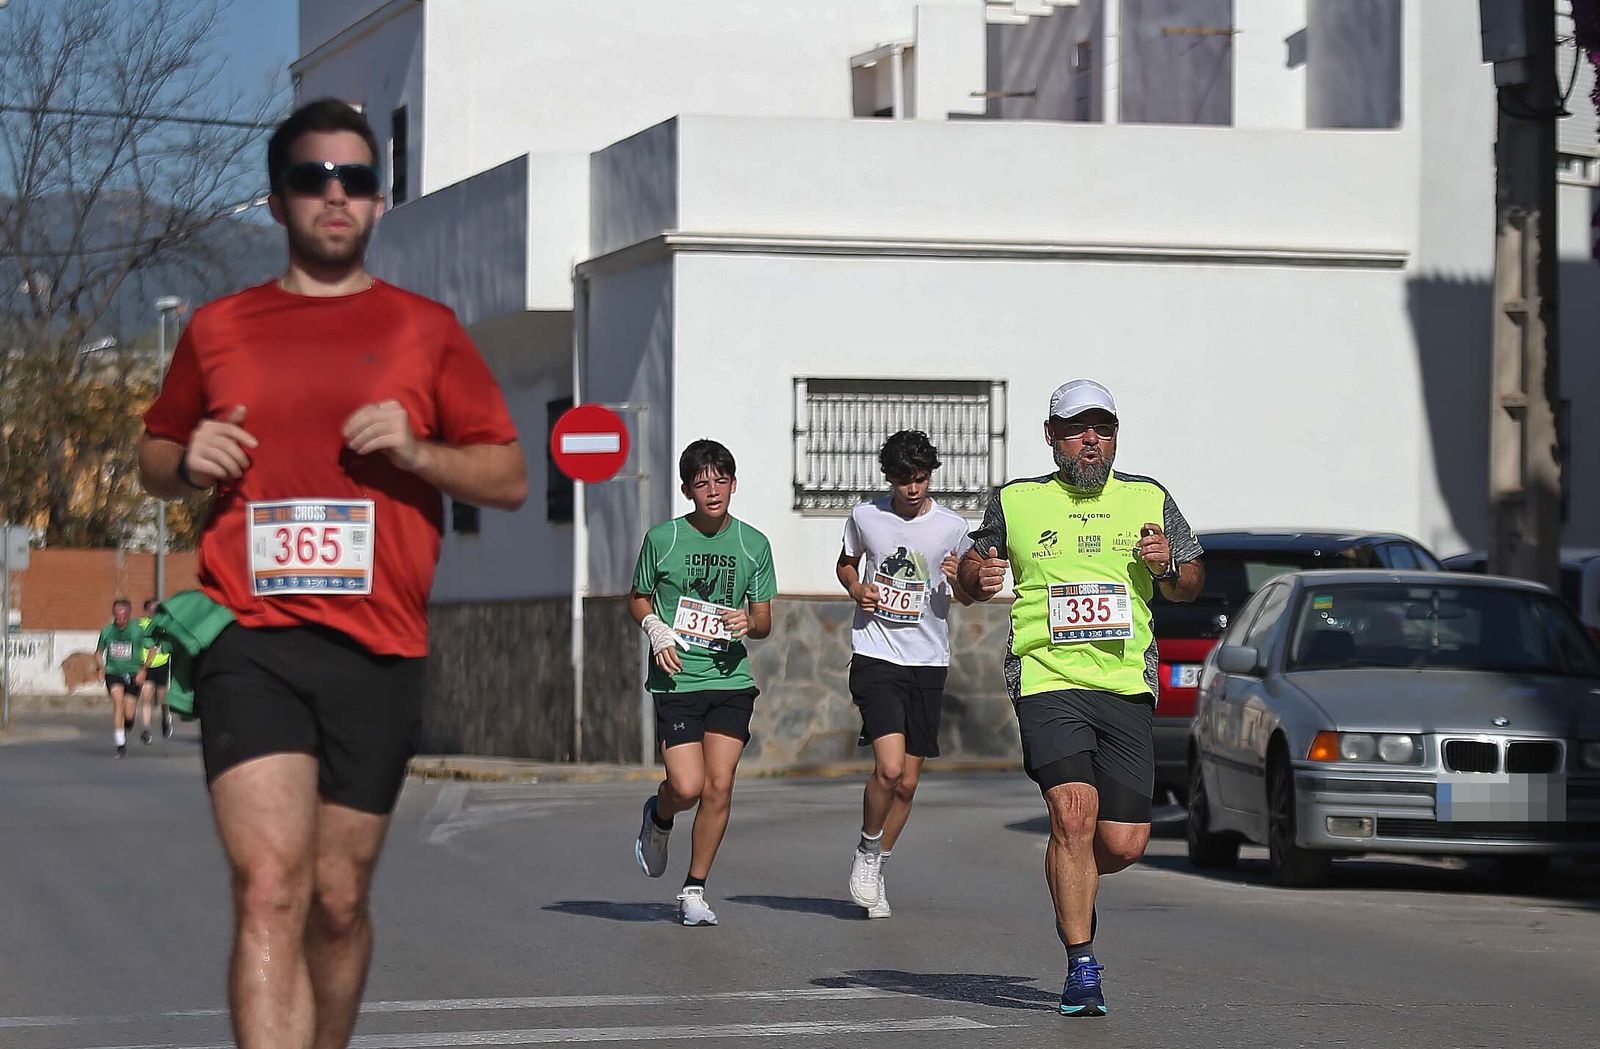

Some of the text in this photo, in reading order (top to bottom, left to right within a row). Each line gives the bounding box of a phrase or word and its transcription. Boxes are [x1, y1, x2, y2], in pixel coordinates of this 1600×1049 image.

[295, 506, 326, 521] CROSS
[275, 527, 342, 565] 365
[692, 553, 736, 568] CROSS
[881, 587, 911, 609] 376
[1079, 584, 1099, 595] CROSS
[1067, 598, 1111, 623] 335
[688, 612, 720, 635] 313
